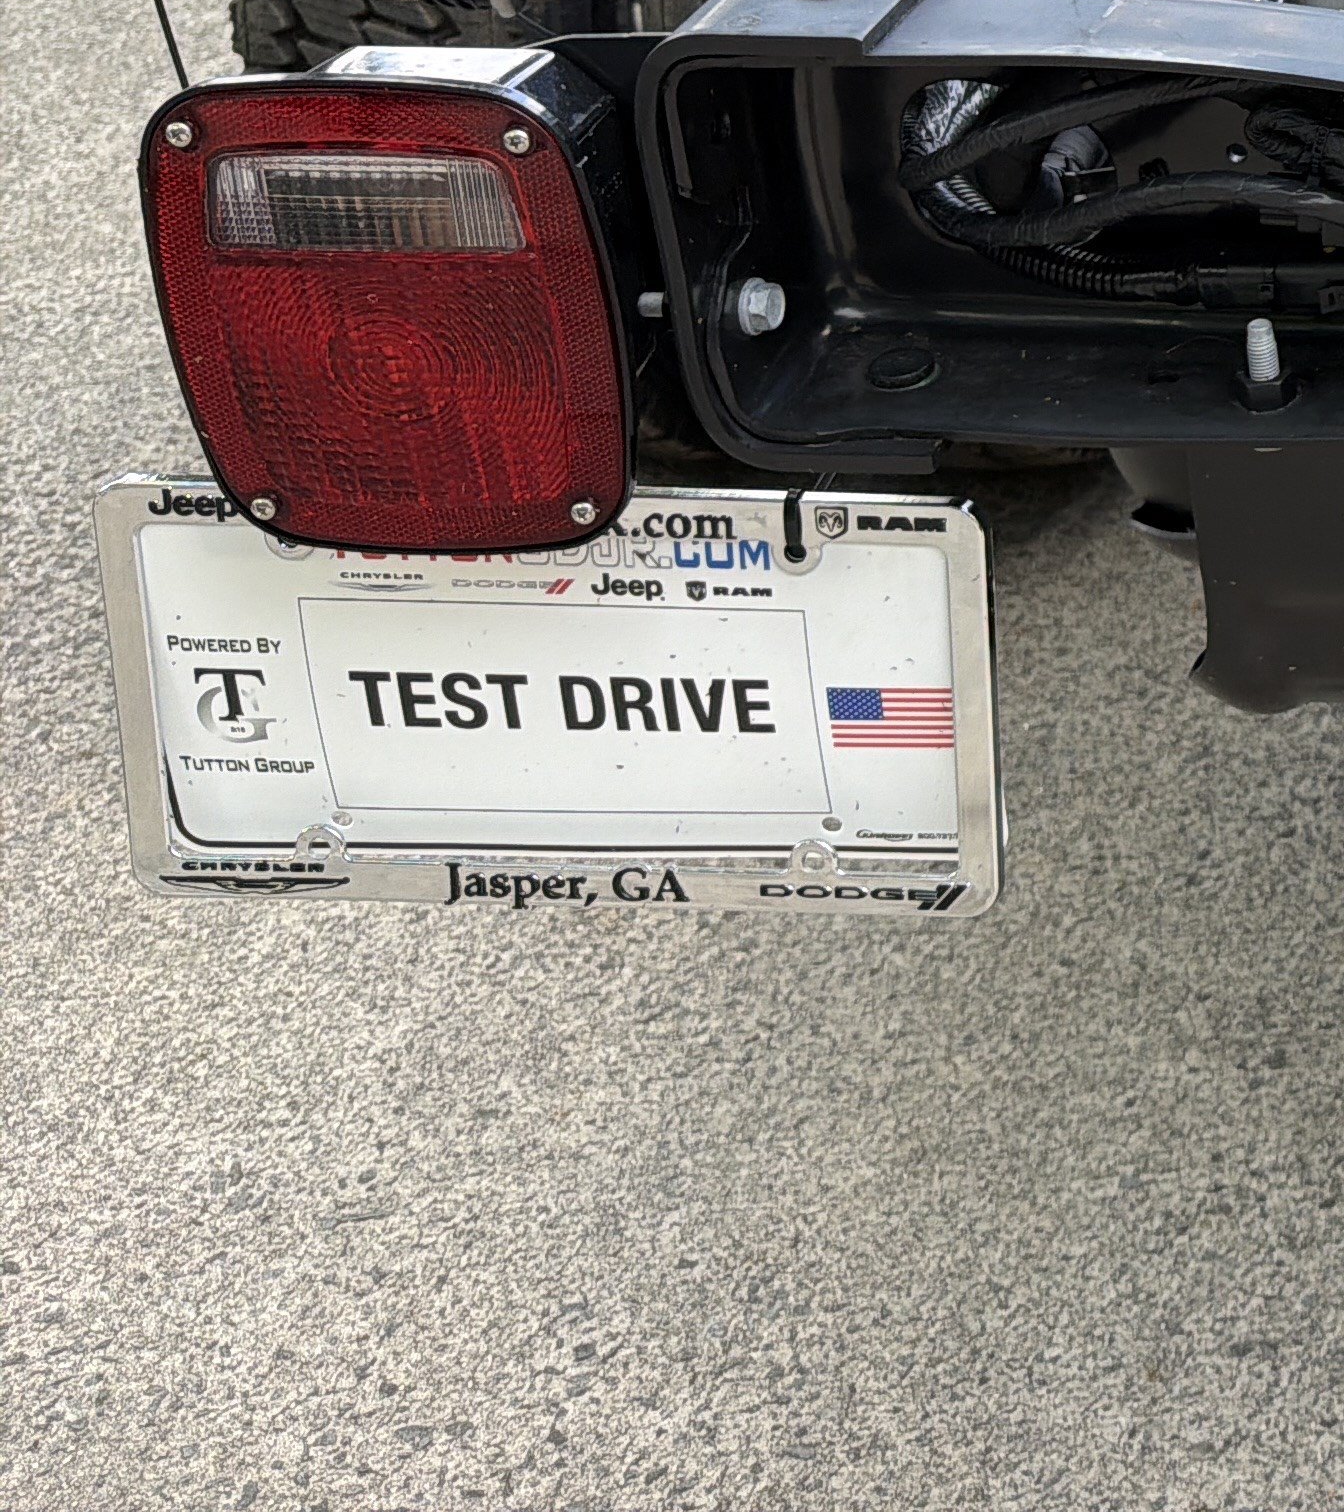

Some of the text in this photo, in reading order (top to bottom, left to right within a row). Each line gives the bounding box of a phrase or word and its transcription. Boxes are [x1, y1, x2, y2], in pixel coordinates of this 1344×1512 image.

[147, 488, 240, 523] Jeep
[857, 515, 948, 533] RAM
[339, 571, 425, 581] CHRYSLER
[451, 578, 552, 590] DODGE
[590, 573, 665, 601] Jeep
[713, 586, 773, 598] RAM
[167, 635, 281, 654] POWERED BY
[348, 670, 777, 734] TEST DRIVE
[179, 755, 315, 774] TUTTON GROUP
[181, 861, 325, 873] CHRYSLER
[444, 861, 691, 910] Jasper, GA
[760, 884, 938, 902] DODGE
